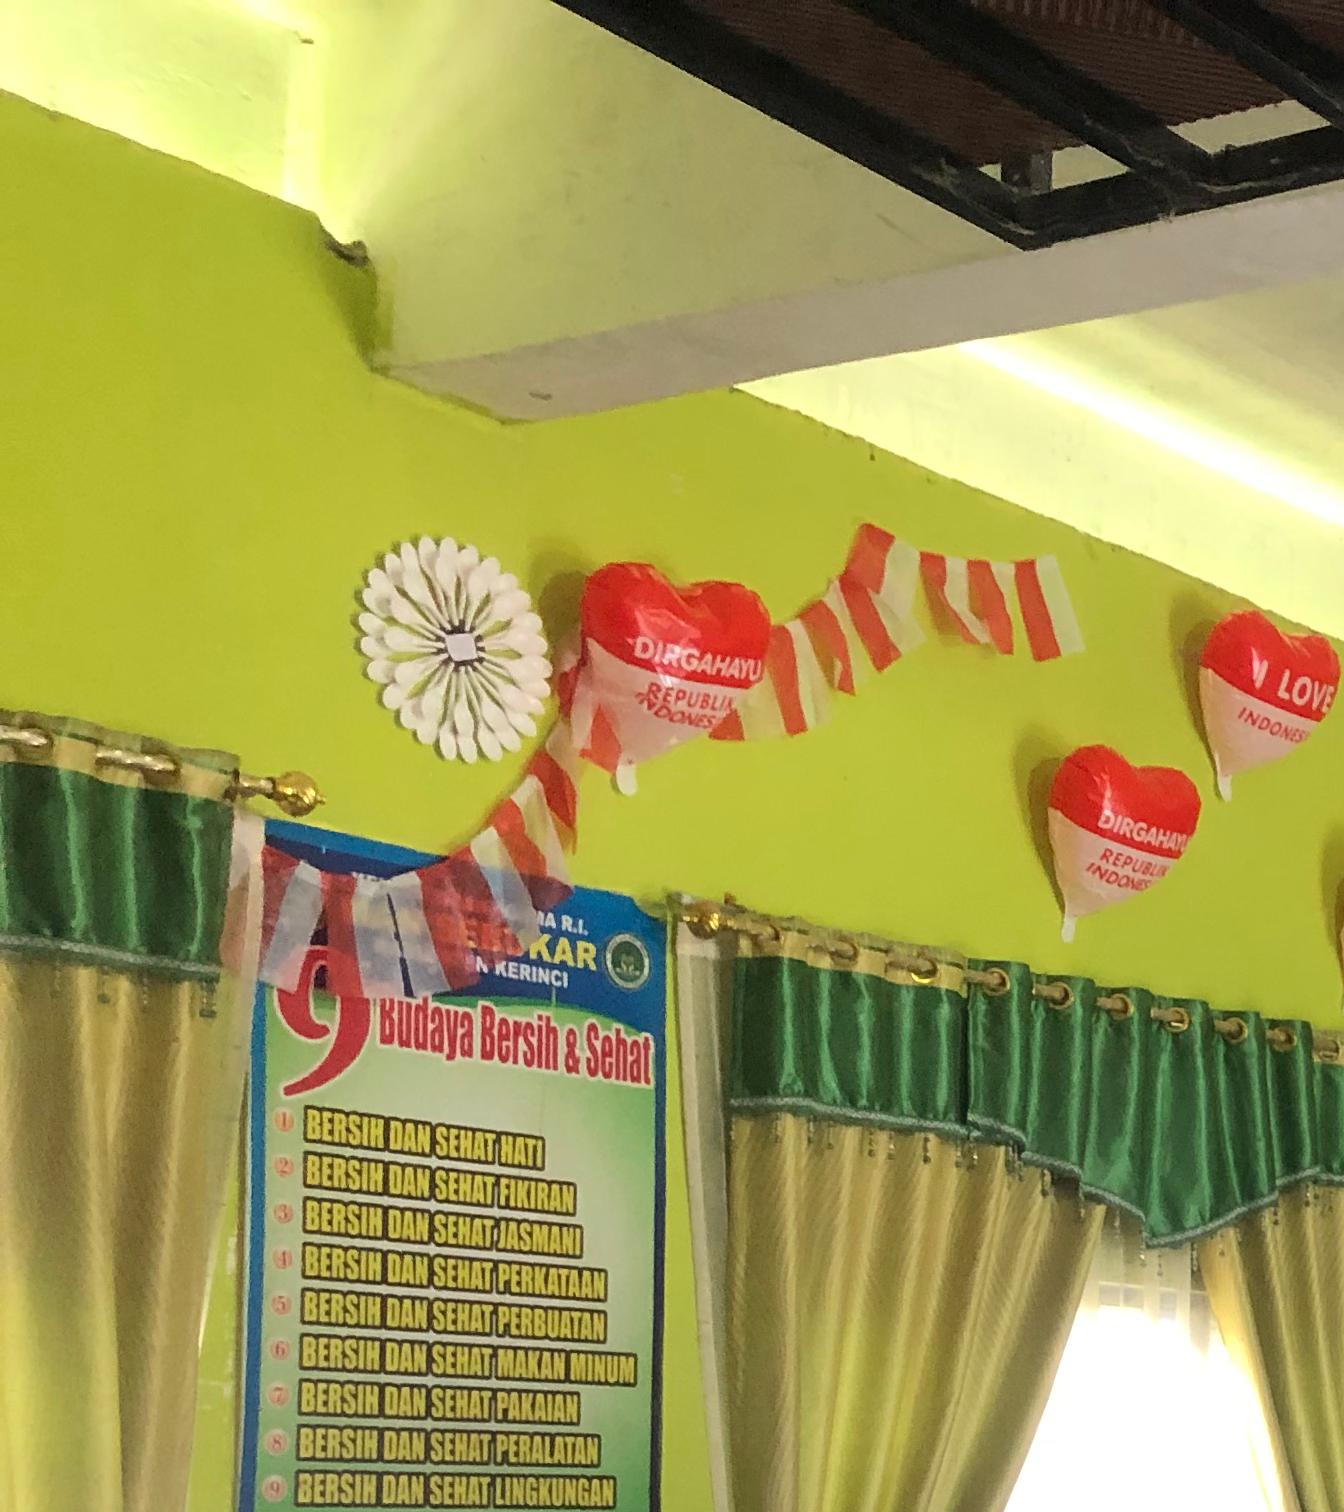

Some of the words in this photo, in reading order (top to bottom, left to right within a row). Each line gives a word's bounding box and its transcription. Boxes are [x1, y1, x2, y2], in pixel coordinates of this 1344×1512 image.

[634, 636, 762, 681] DIRGAHAYU
[1278, 668, 1335, 713] LOVE
[494, 959, 569, 989] KERINCI
[275, 944, 371, 1097] 9
[379, 995, 474, 1062] Budaya
[480, 1004, 559, 1072] Bersih
[564, 1030, 580, 1075] &
[585, 1022, 655, 1086] Sehat
[306, 1108, 385, 1150] BERSIH
[389, 1119, 431, 1156] DAN
[435, 1125, 496, 1163] SEHAT
[500, 1133, 544, 1169] HATI
[306, 1155, 383, 1195] BERSIH
[389, 1163, 430, 1200] DAN
[434, 1168, 496, 1206] SEHAT
[499, 1175, 576, 1214] FIKIRAN
[304, 1201, 383, 1239] BERSIH
[387, 1208, 429, 1243] DAN
[433, 1213, 494, 1248] SEHAT
[496, 1218, 582, 1256] JASMANI
[303, 1247, 382, 1284] BERSIH
[387, 1253, 428, 1287] DAN
[433, 1257, 493, 1292] SEHAT
[498, 1262, 606, 1300] PERKATAAN
[302, 1292, 381, 1329] BERSIH
[386, 1298, 428, 1332] DAN
[432, 1301, 493, 1336] SEHAT
[497, 1305, 605, 1343] PERBUATAN
[301, 1338, 380, 1372] BERSIH
[385, 1342, 427, 1375] DAN
[431, 1344, 492, 1378] SEHAT
[496, 1348, 565, 1382] MAKAN
[569, 1351, 636, 1386] MINUM
[300, 1384, 379, 1417] BERSIH
[384, 1387, 426, 1419] DAN
[431, 1388, 492, 1421] SEHAT
[496, 1391, 579, 1425] PAKAIAN
[298, 1428, 377, 1461] BERSIH
[383, 1431, 425, 1462] DAN
[429, 1432, 491, 1463] SEHAT
[495, 1434, 599, 1465] PERALATAN
[297, 1474, 376, 1505] BERSIH
[382, 1475, 424, 1506] DAN
[429, 1476, 491, 1506] SEHAT
[494, 1477, 615, 1507] LINGKUNGAN
